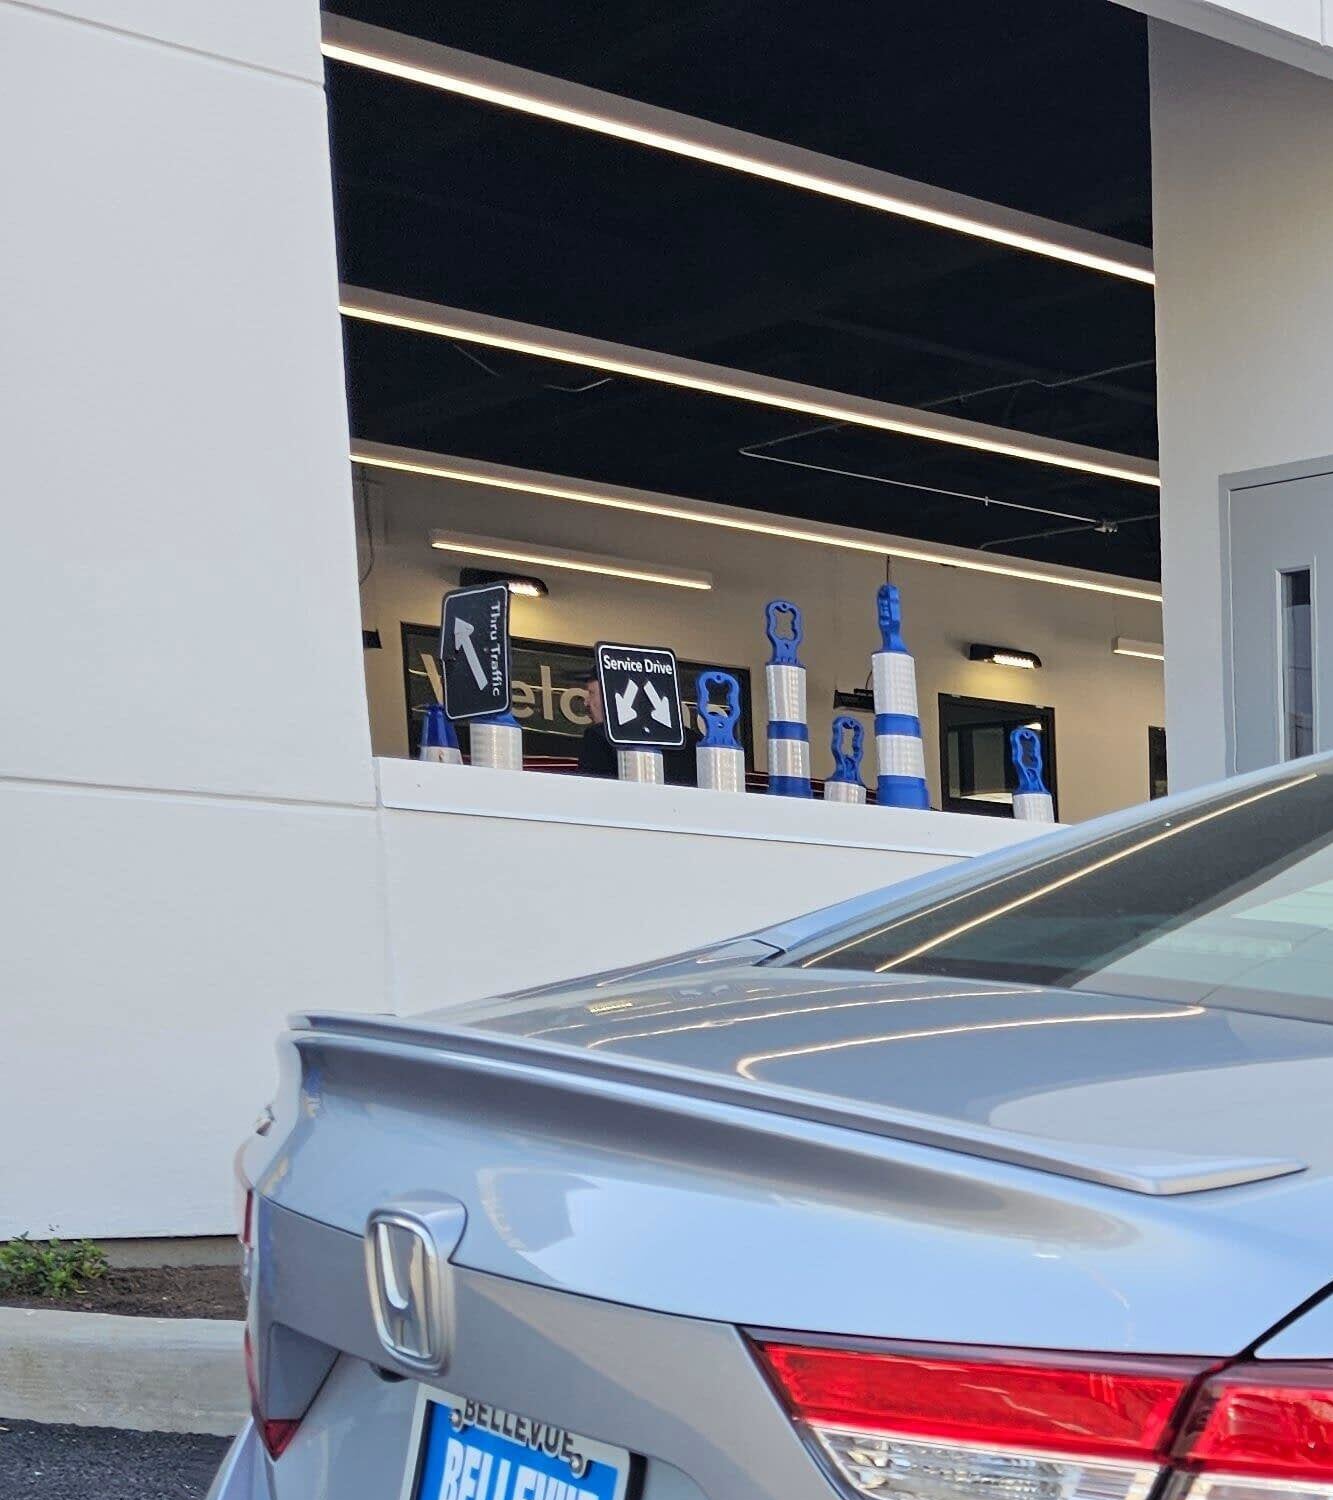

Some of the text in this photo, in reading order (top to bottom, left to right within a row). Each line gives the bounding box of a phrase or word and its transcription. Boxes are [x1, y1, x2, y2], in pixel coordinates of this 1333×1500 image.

[490, 601, 503, 697] Thru Traffic
[603, 654, 673, 675] Service Drive
[463, 1399, 575, 1457] BELLEVUE
